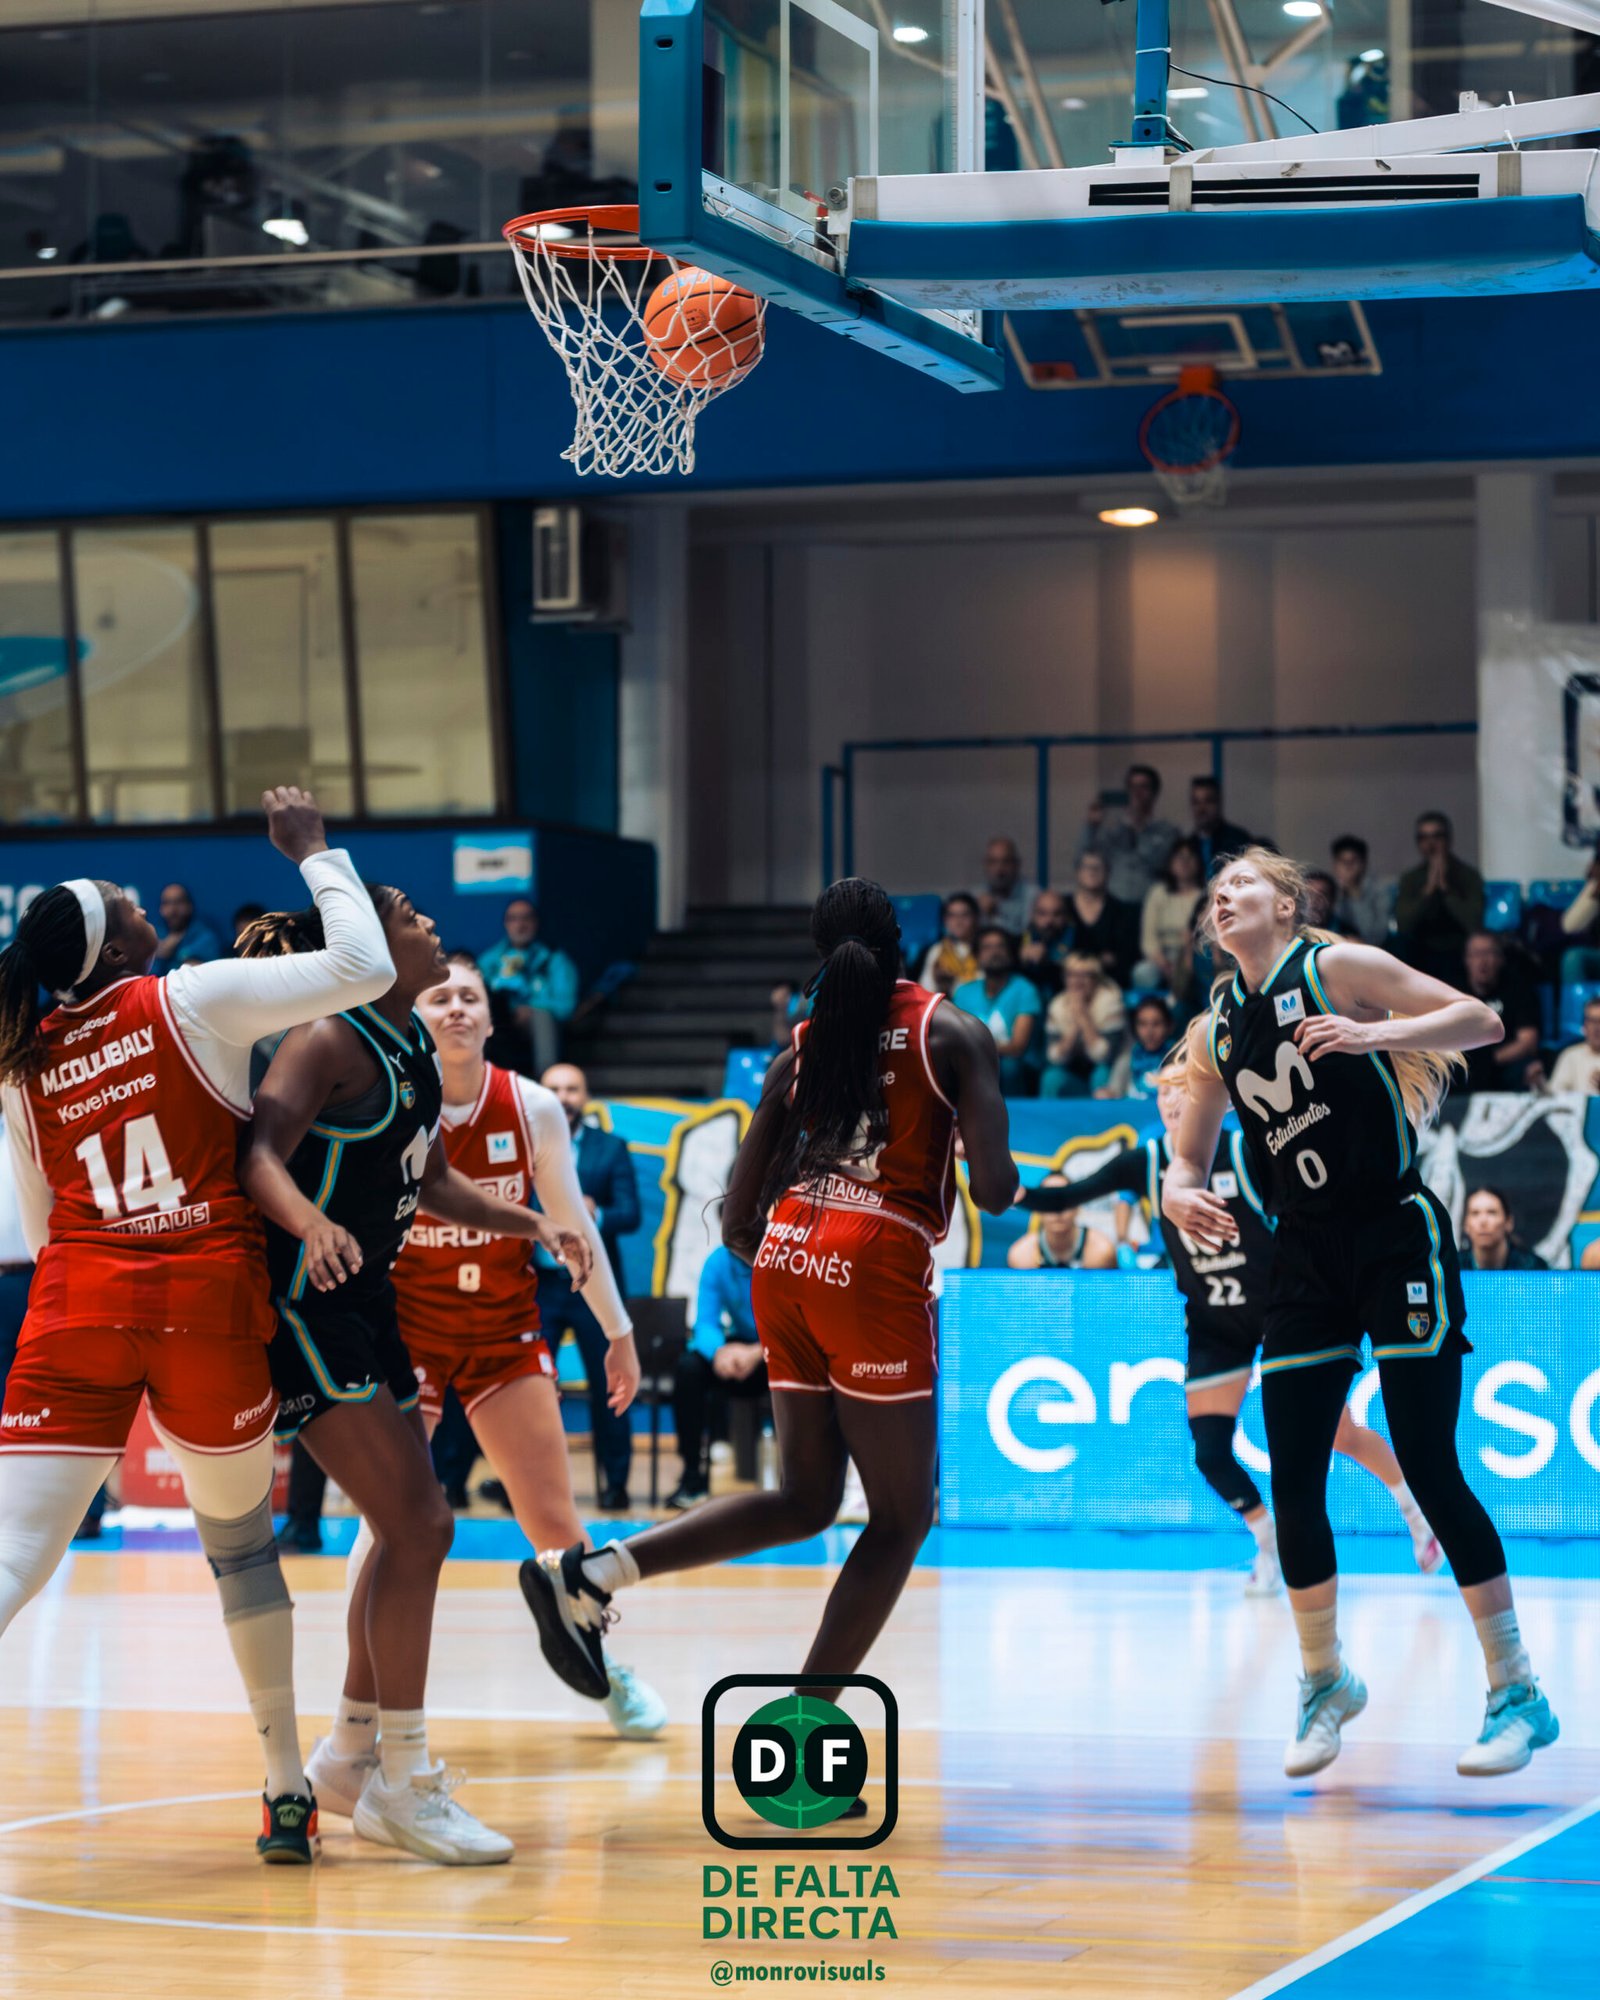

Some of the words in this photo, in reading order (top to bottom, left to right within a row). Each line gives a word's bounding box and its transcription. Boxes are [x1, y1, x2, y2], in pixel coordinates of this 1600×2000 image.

[40, 1023, 155, 1098] M.COULIBALY
[1265, 1101, 1331, 1156] Estudiantes
[75, 1113, 187, 1221] 14
[1296, 1149, 1329, 1190] 0
[1205, 1275, 1247, 1306] 22
